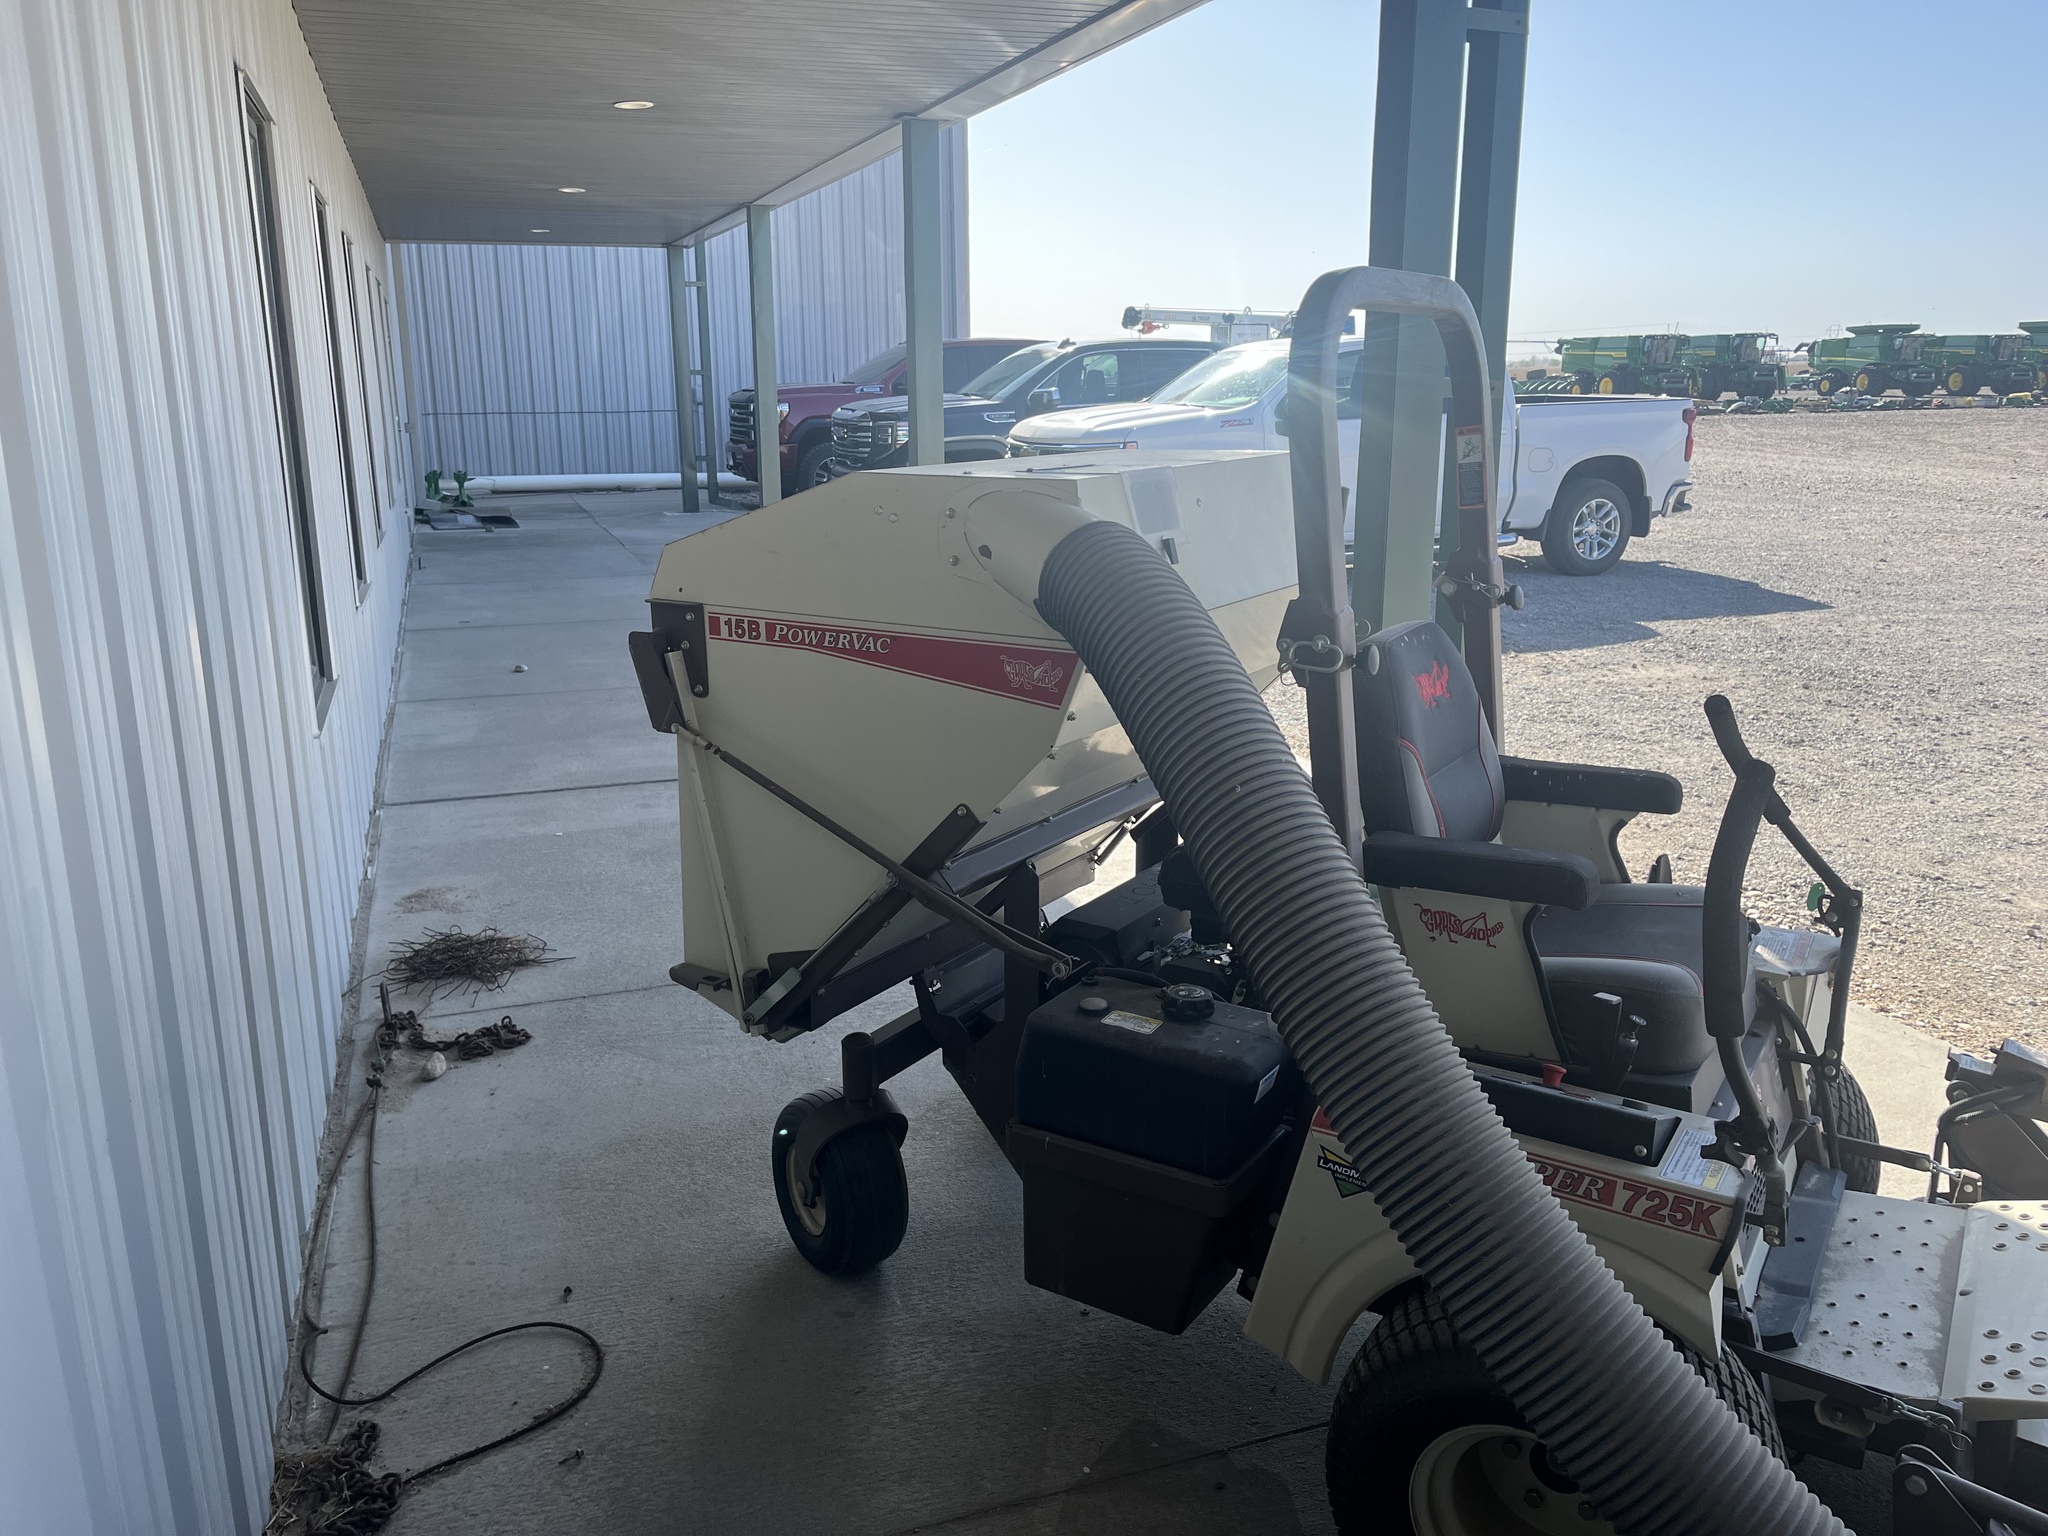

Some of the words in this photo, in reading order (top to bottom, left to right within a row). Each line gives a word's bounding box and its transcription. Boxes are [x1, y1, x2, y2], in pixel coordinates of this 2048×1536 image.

[724, 617, 761, 641] 15B
[773, 624, 891, 654] POWERVAC
[1319, 1158, 1361, 1179] LANDM
[1335, 1173, 1367, 1187] IMPLEMEN
[1622, 1182, 1721, 1238] 725K
